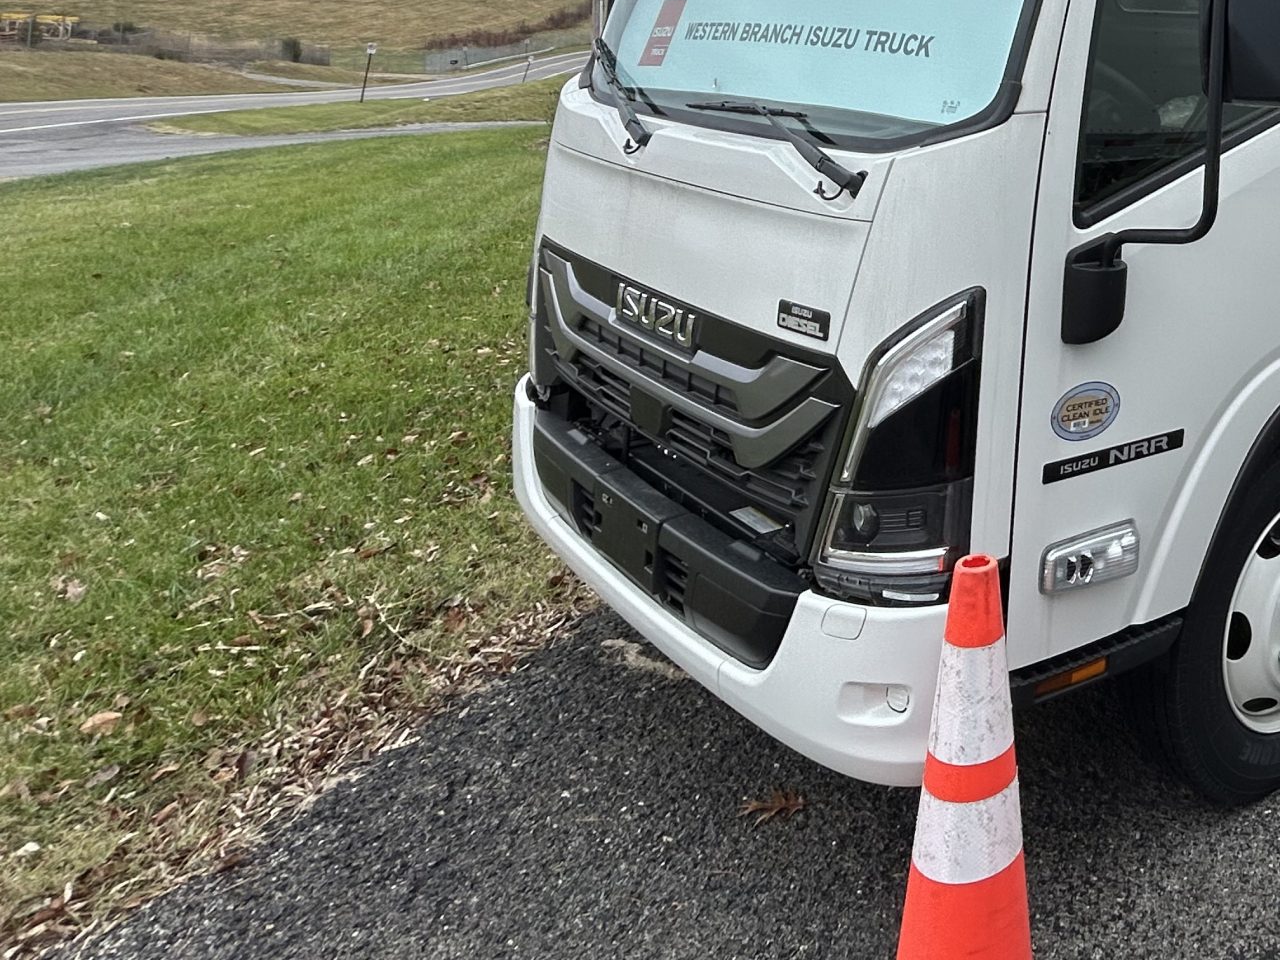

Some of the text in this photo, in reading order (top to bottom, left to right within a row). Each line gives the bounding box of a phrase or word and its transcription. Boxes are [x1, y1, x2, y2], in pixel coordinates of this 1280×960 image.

[651, 26, 674, 38] ISUZU
[685, 22, 935, 58] WESTERN BRANCH ISUZU TRUCK
[616, 282, 696, 347] ISUZU
[791, 305, 813, 318] ISUZU
[779, 312, 824, 338] DIESEL
[1061, 411, 1090, 423] CLEAN
[1092, 406, 1111, 416] IDLE
[1066, 397, 1108, 413] CERTIFIED
[1060, 436, 1169, 475] ISUZU NRR
